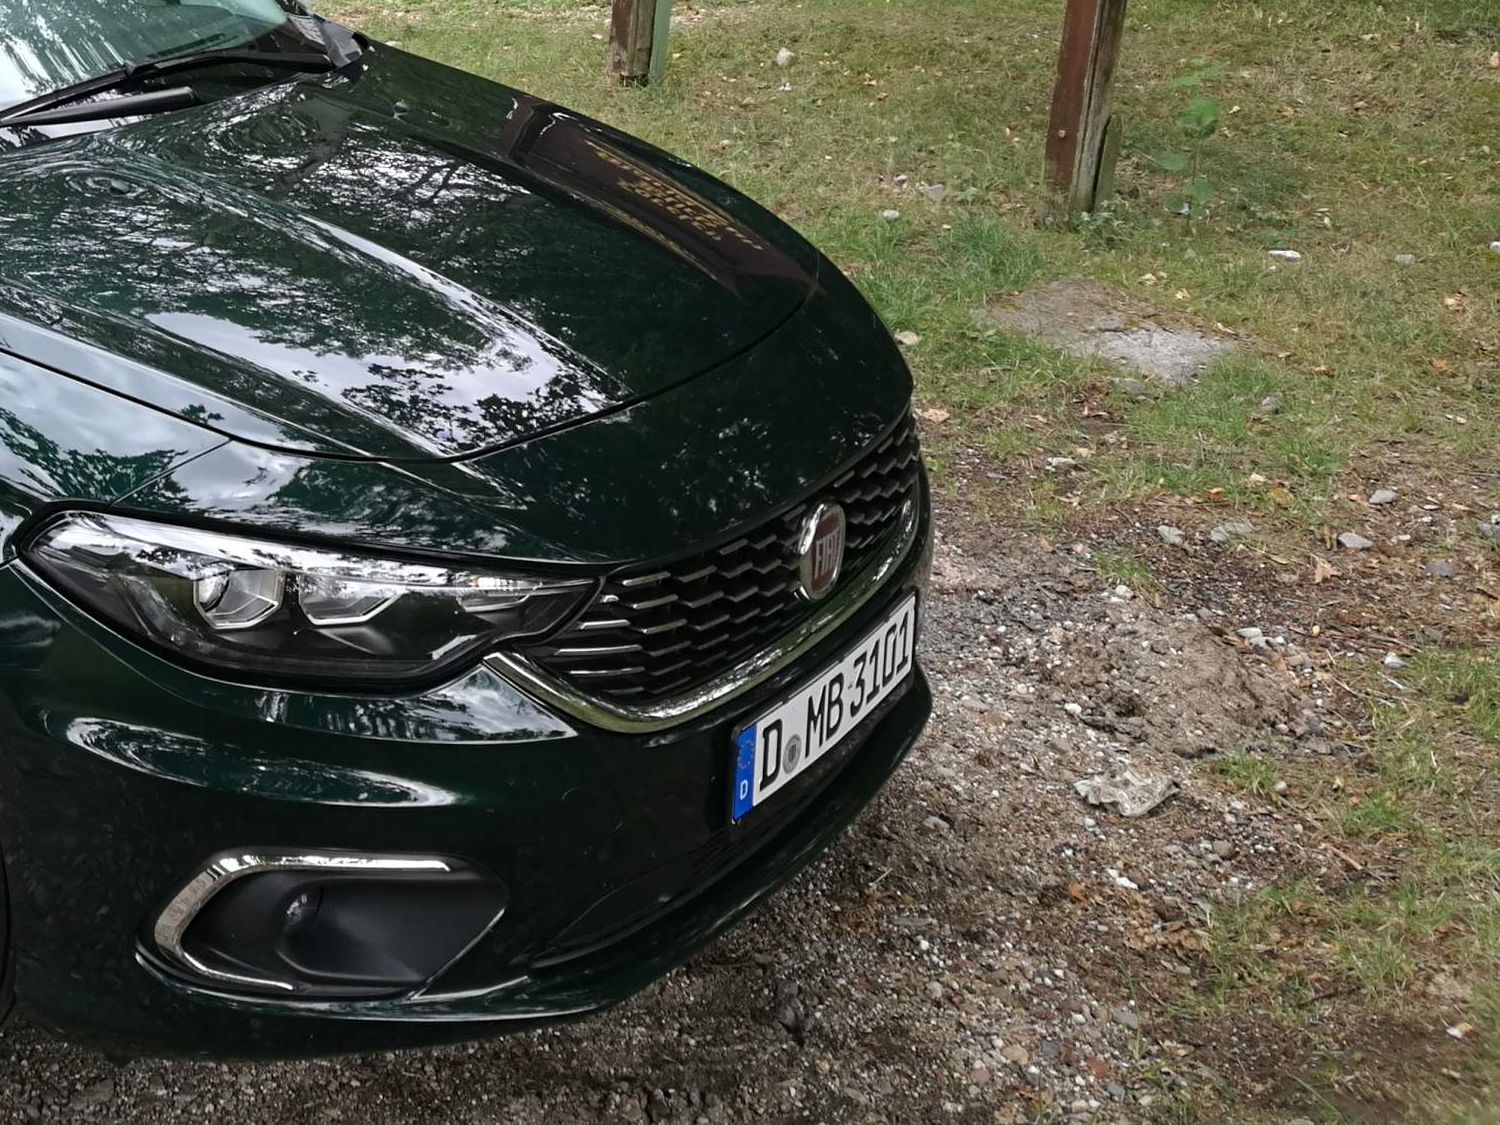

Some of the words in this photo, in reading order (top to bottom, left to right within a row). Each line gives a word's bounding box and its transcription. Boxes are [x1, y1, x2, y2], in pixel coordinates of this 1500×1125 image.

[814, 530, 841, 579] FIAT
[760, 718, 783, 792] D
[850, 611, 909, 718] 3101
[740, 779, 749, 801] D
